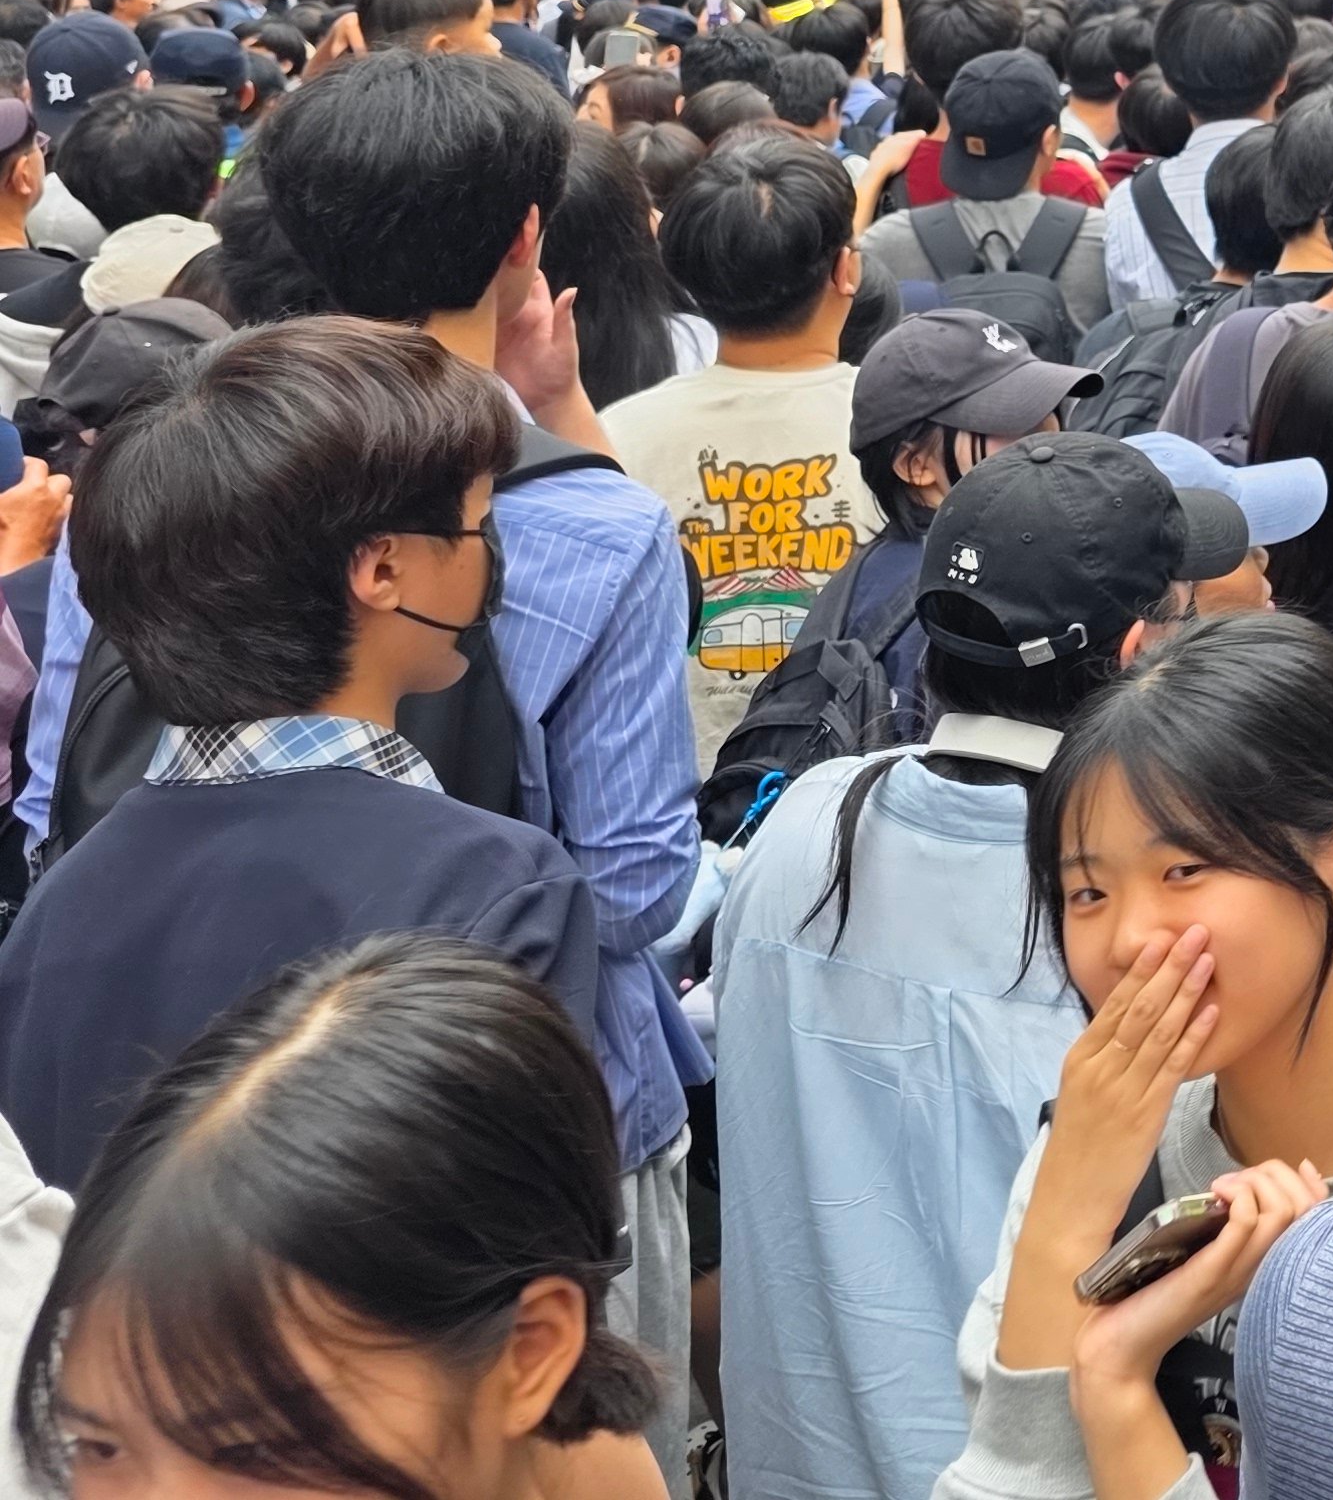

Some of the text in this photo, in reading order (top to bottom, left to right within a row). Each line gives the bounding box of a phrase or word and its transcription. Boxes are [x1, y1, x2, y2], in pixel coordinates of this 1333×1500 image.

[45, 72, 75, 105] D
[703, 457, 834, 503] WORK
[686, 521, 710, 535] The
[727, 501, 803, 535] FOR
[680, 525, 852, 580] WEEKEND
